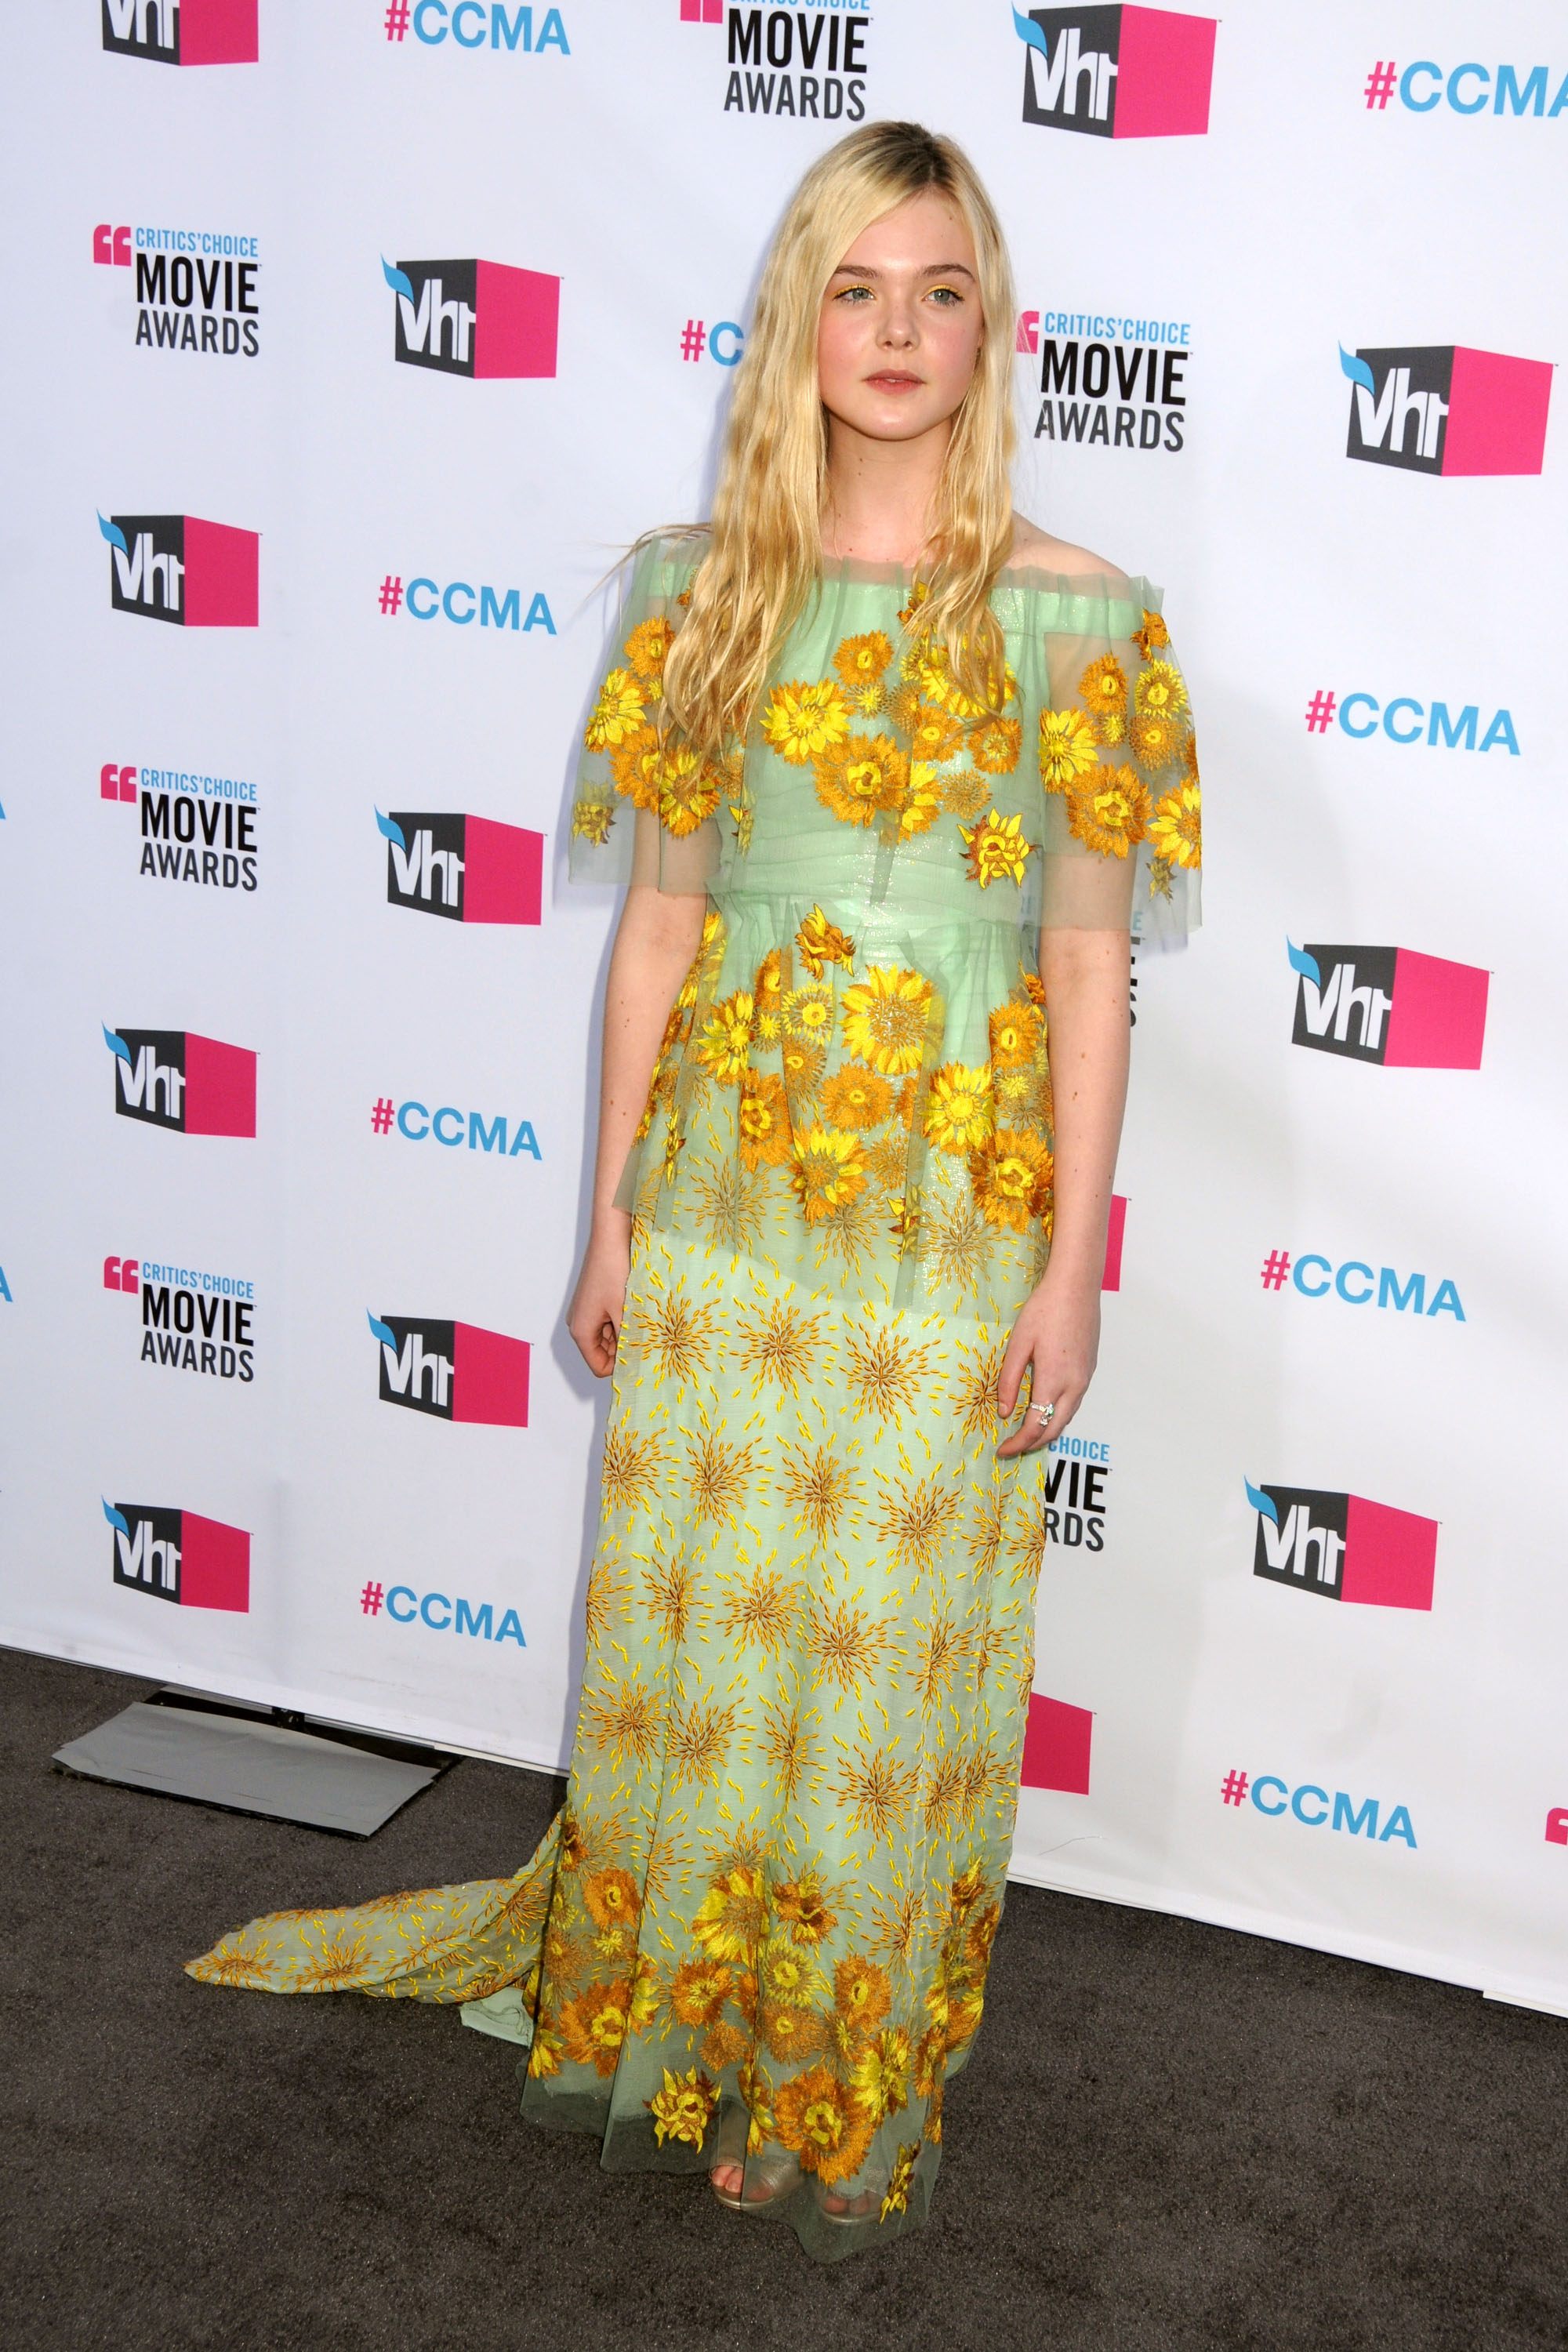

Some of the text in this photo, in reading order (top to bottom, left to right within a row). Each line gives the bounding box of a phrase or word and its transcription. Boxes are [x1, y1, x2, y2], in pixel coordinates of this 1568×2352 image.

[385, 0, 571, 55] #CCMA
[728, 8, 869, 73] MOVIE
[724, 71, 866, 122] AWARDS
[136, 252, 259, 314] MOVIE
[136, 309, 259, 357] AWARDS
[1041, 339, 1188, 406] MOVIE
[1034, 400, 1185, 452] AWARDS
[378, 575, 557, 636] #CCMA
[1305, 690, 1520, 756] #CCMA
[142, 792, 257, 853] MOVIE
[140, 843, 257, 891] AWARDS
[371, 1098, 543, 1160] #CCMA
[143, 1283, 254, 1347] MOVIE
[1261, 1250, 1466, 1322] #CCMA
[141, 1330, 254, 1382] AWARDS
[1044, 1459, 1108, 1514] VIE
[1044, 1508, 1105, 1552] RDS
[360, 1581, 527, 1648] #CCMA
[1221, 1769, 1417, 1849] #CCMA
